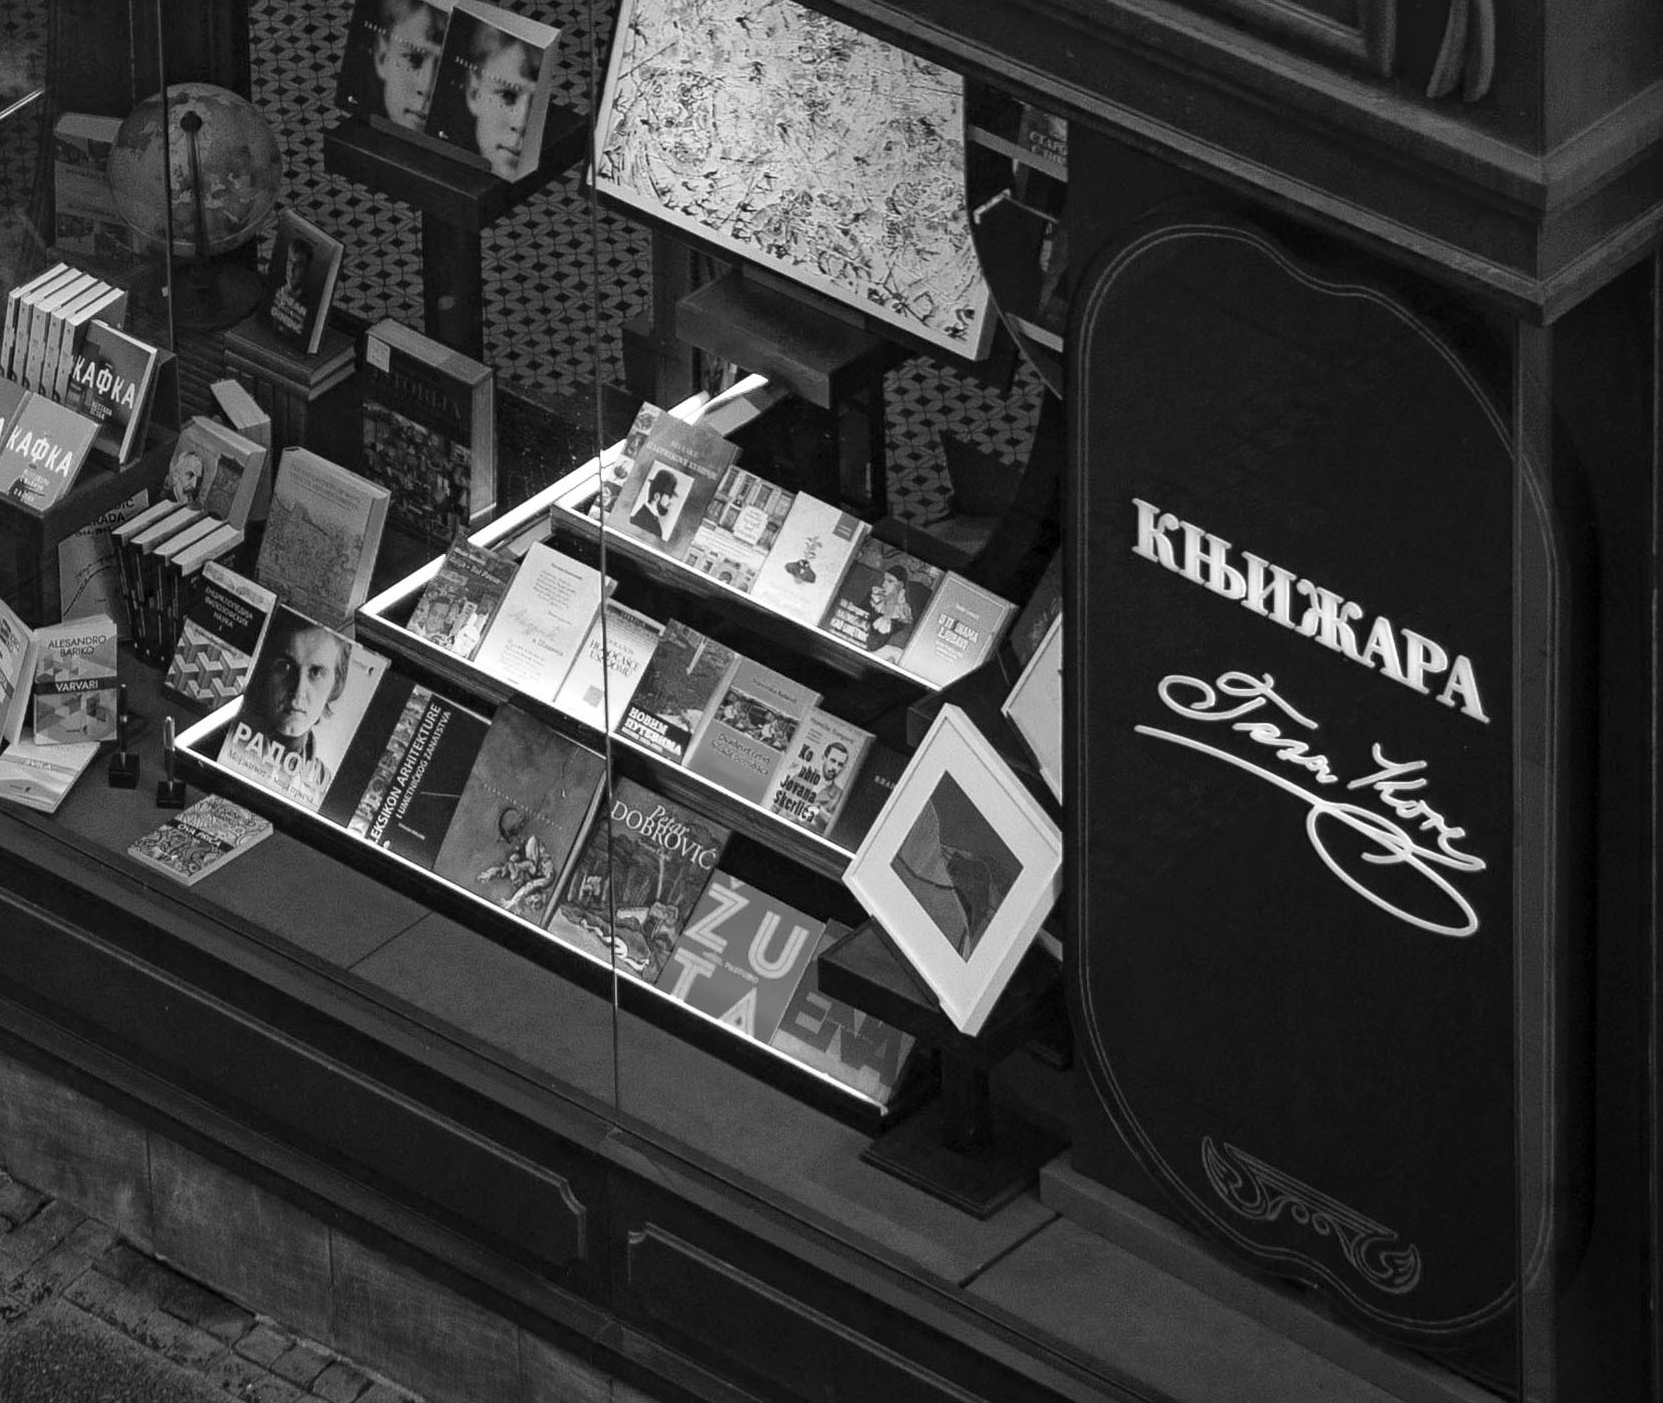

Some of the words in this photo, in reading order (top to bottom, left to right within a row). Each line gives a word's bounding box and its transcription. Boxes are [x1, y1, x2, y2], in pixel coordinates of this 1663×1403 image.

[72, 354, 136, 410] КАФКА
[5, 424, 73, 478] КАФКА
[1131, 496, 1491, 725] КЊИЖАРА
[47, 634, 107, 650] ALESANDRO
[59, 645, 95, 658] BARIKO
[55, 679, 99, 693] VARVARI
[396, 703, 443, 788] ARHITEKTURE
[424, 710, 452, 762] ZANATSTVA
[798, 743, 814, 763] Ko
[780, 774, 817, 804] Jovana
[798, 765, 821, 786] ubio
[648, 804, 691, 837] Petar
